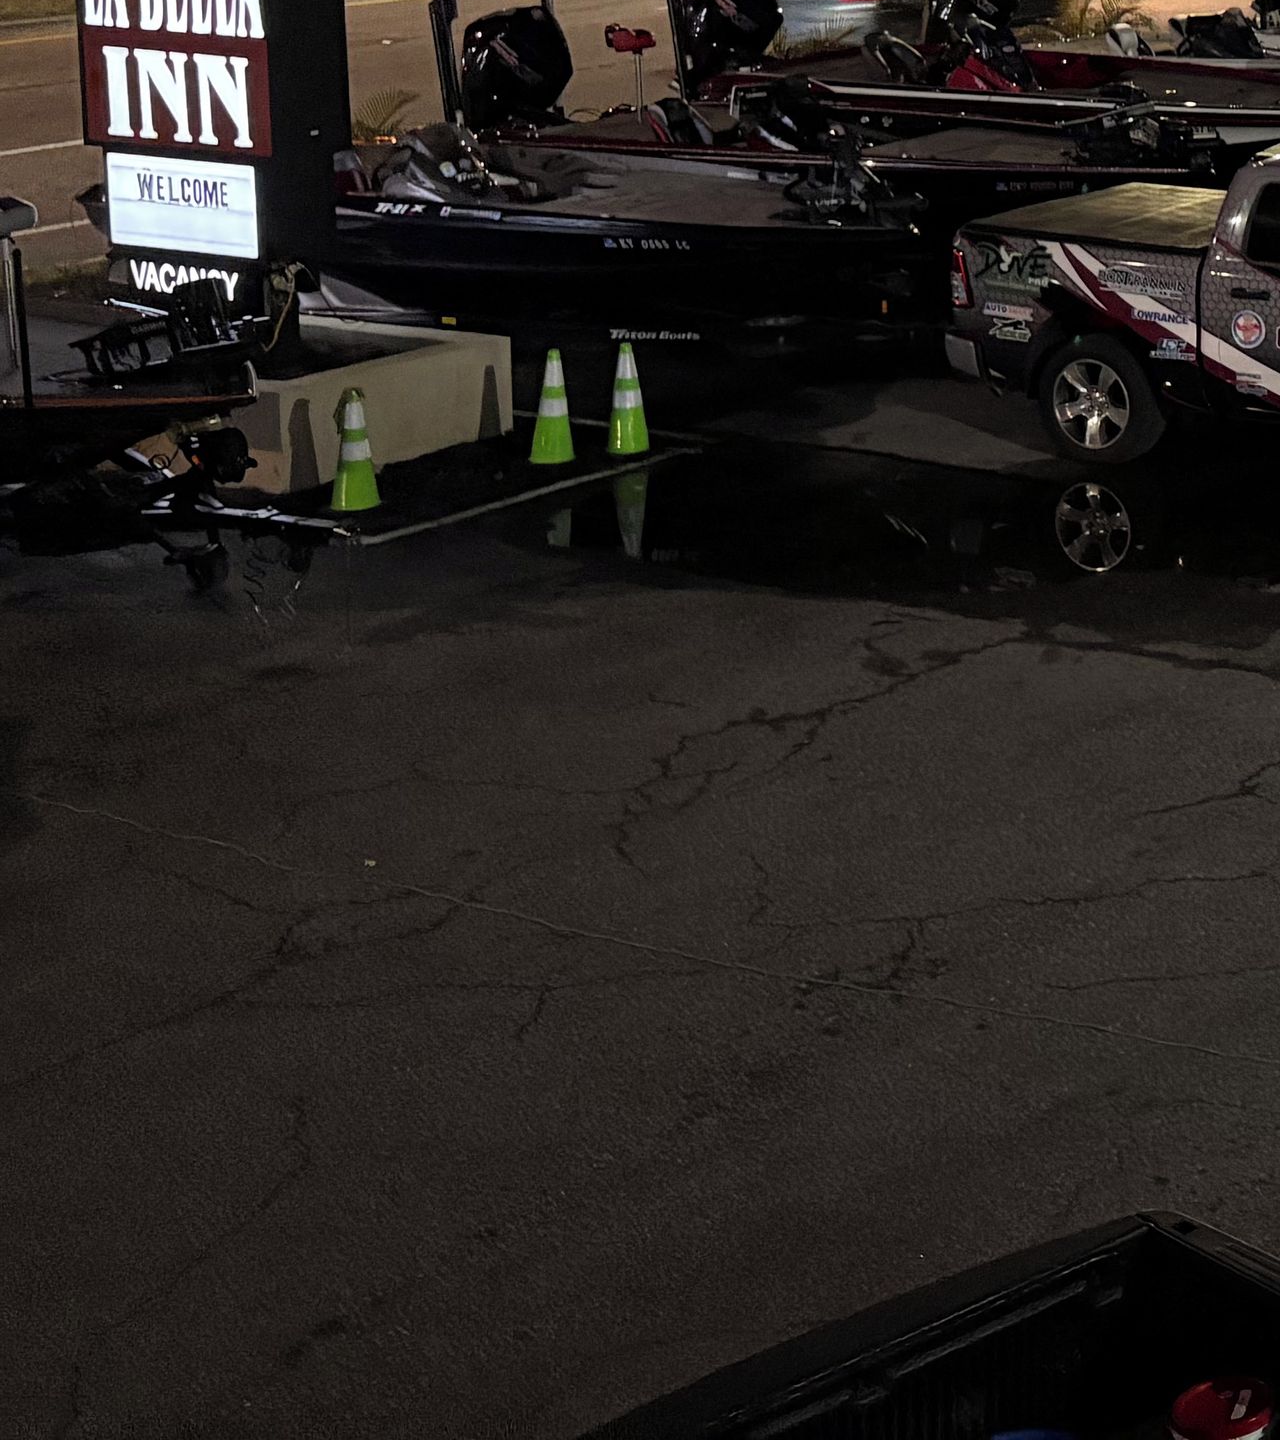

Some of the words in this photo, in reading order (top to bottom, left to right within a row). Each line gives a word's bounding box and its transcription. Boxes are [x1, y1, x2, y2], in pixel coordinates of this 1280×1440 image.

[102, 45, 254, 148] INN
[137, 173, 228, 208] WELCOME
[1130, 308, 1187, 324] LOWRANCE
